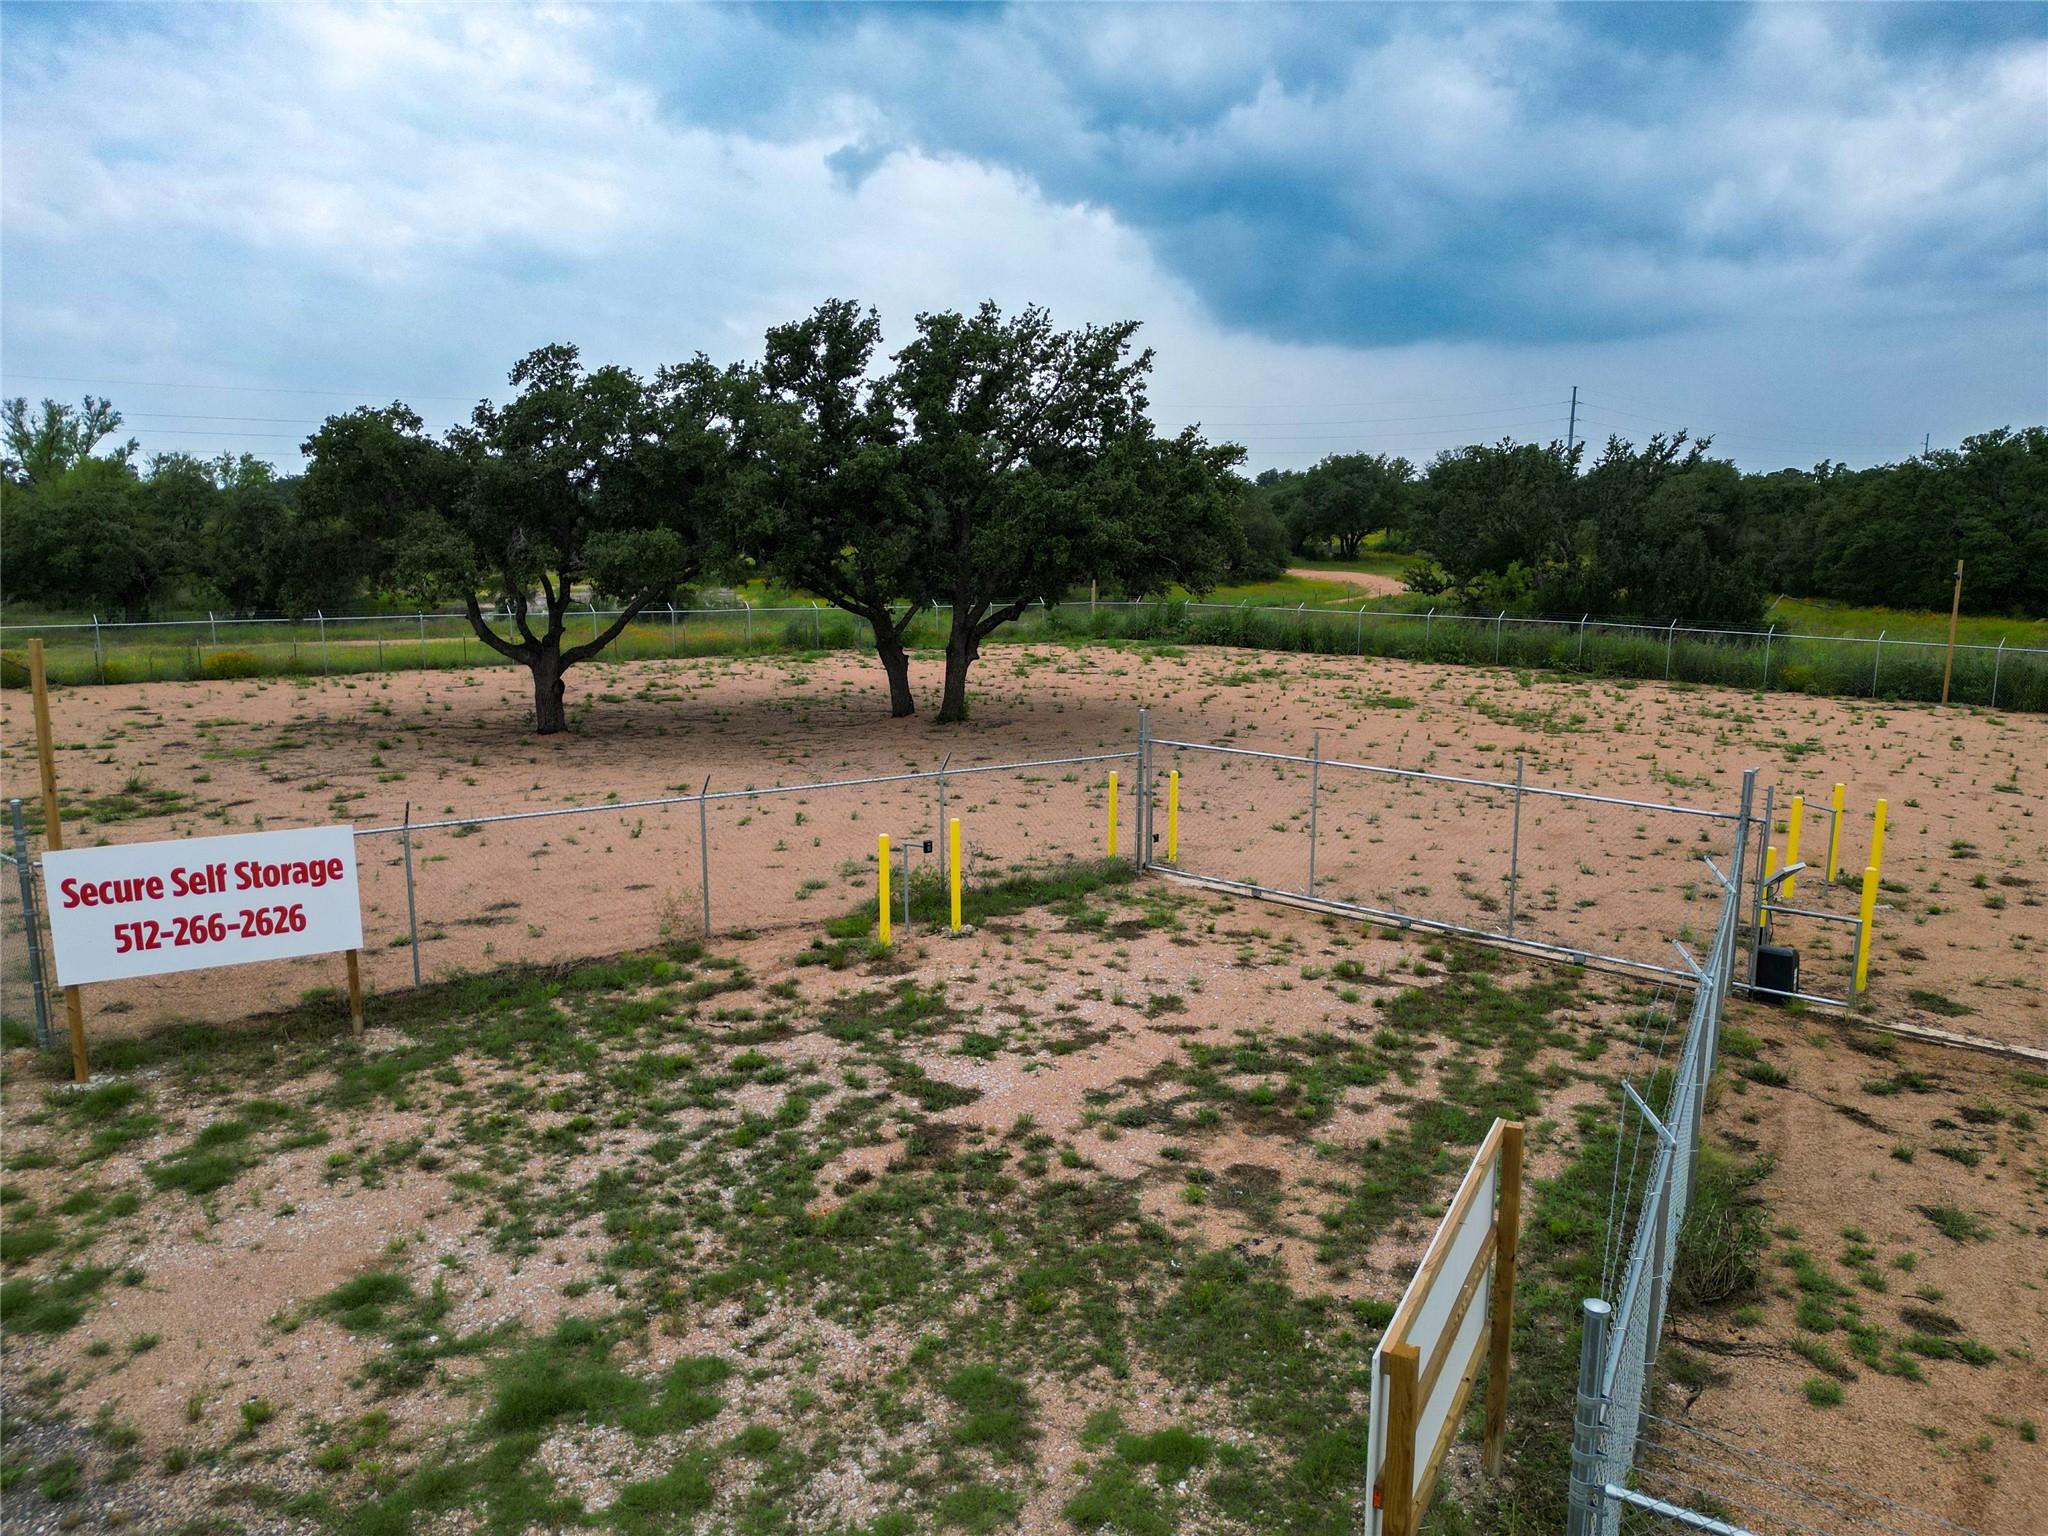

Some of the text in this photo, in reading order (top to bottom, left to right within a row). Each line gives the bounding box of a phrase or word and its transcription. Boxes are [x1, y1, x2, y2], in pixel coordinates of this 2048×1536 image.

[61, 857, 344, 909] Secure Self Storage
[114, 903, 307, 954] 512-266-2626
